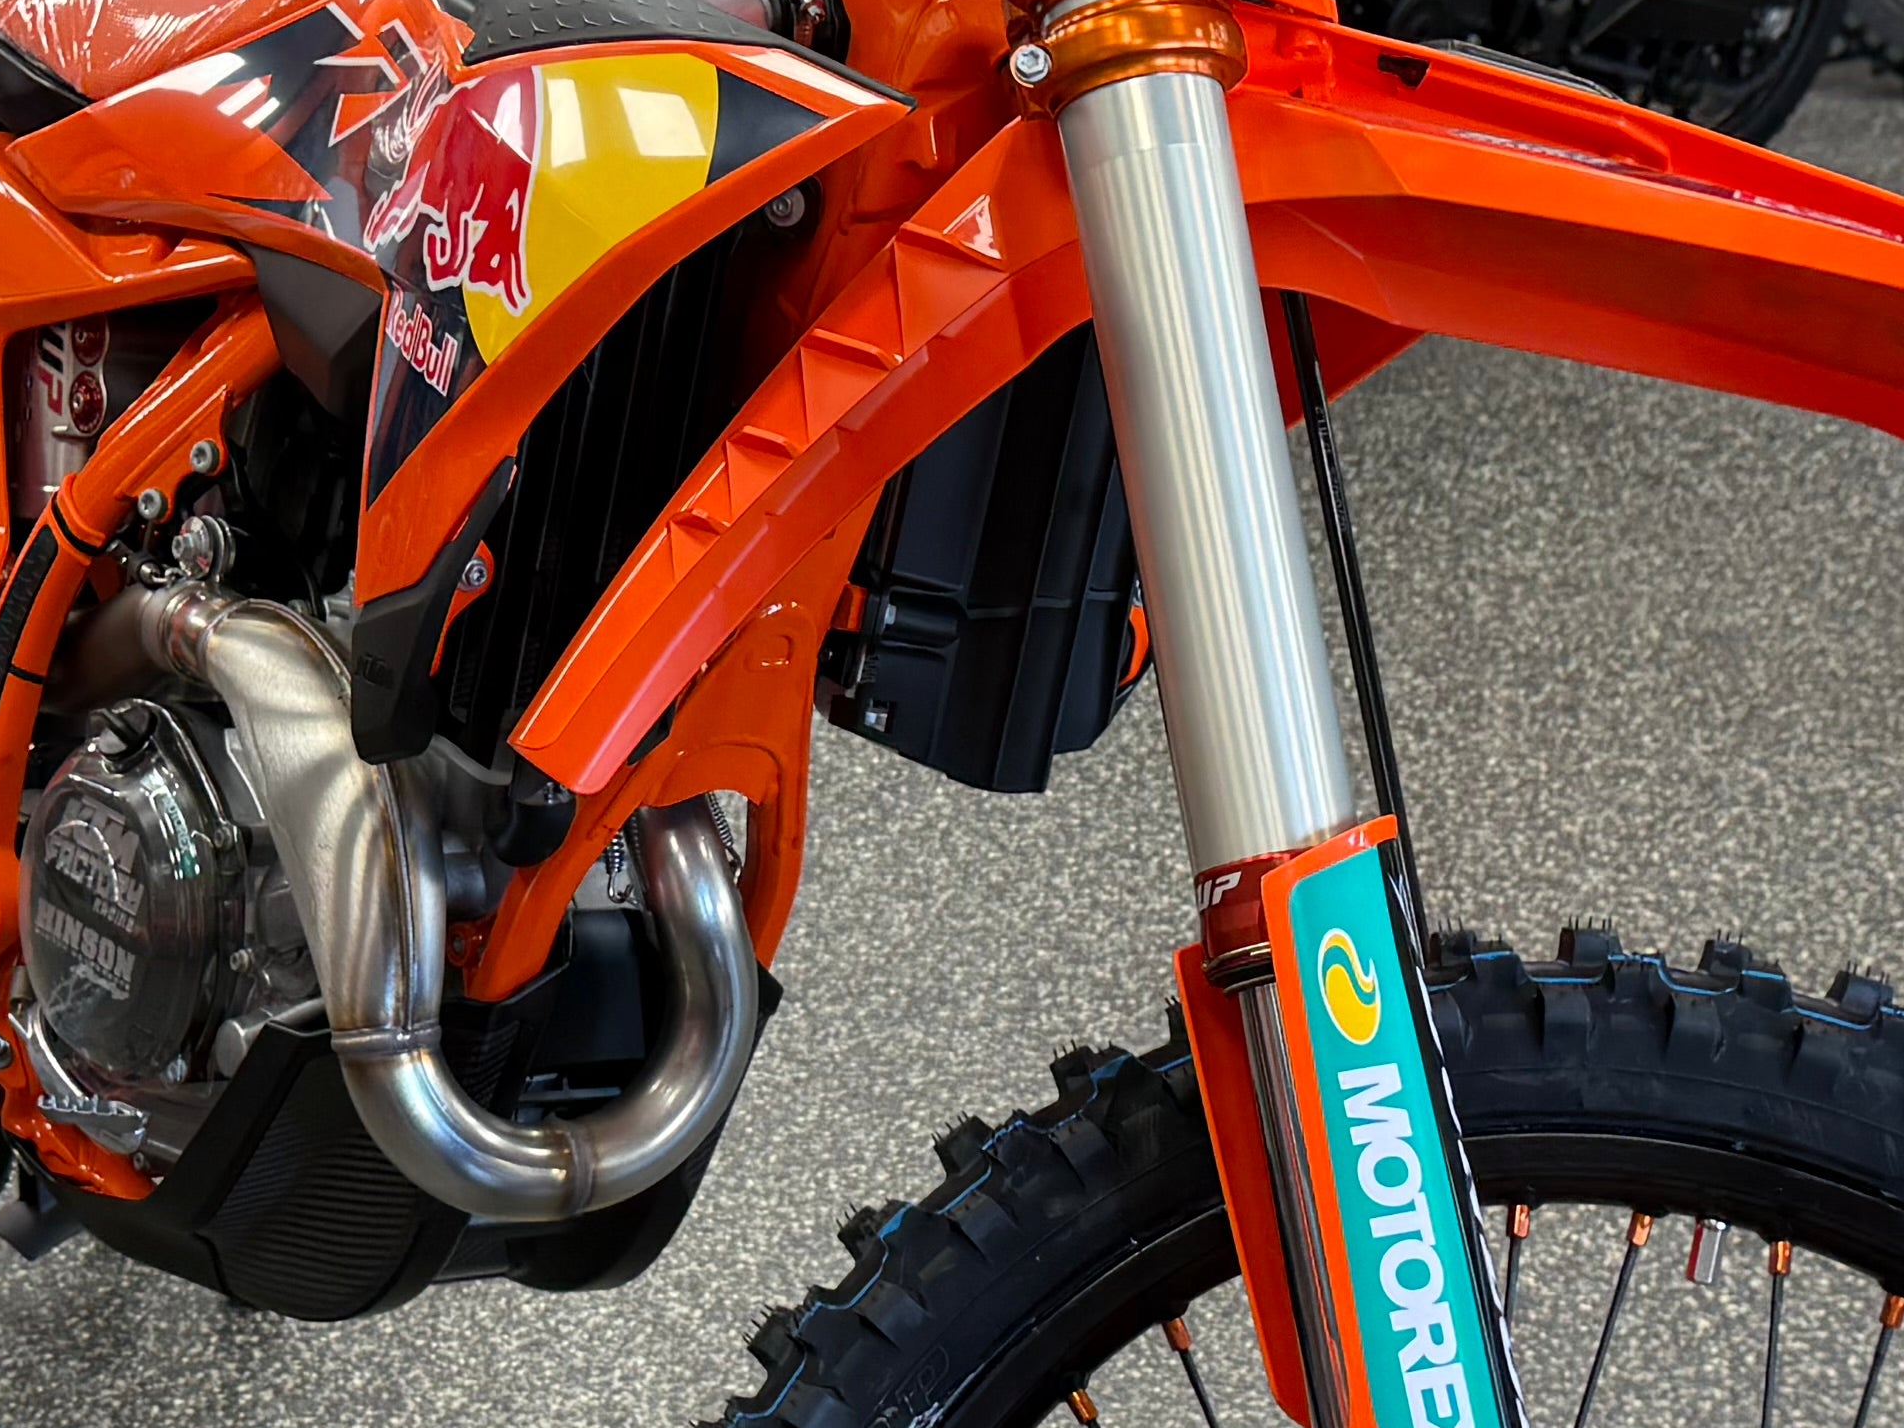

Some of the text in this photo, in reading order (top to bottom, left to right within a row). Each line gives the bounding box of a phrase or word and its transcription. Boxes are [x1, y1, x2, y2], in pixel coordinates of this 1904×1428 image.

[385, 279, 458, 397] Red Bull
[35, 897, 137, 989] HINSON
